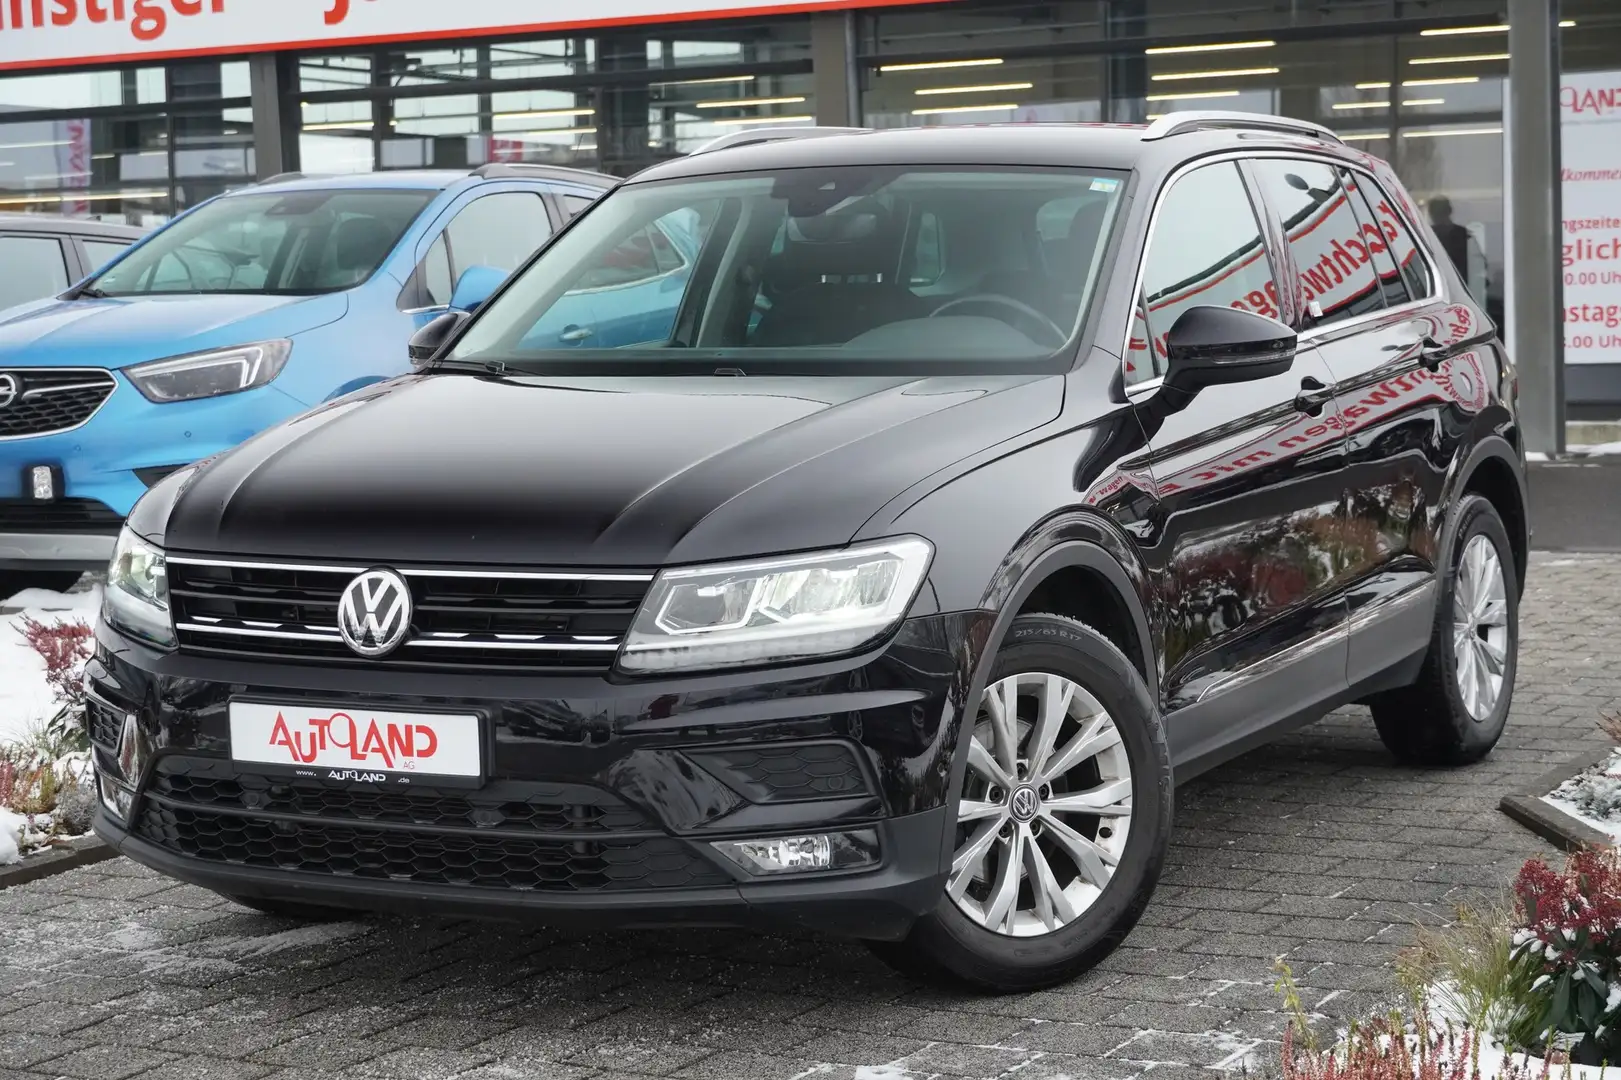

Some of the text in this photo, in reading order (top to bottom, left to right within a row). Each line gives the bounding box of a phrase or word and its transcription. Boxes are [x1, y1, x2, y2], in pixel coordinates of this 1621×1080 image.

[269, 711, 438, 768] AUTOLAND
[403, 760, 415, 770] AG
[328, 769, 386, 783] AUTOLAND
